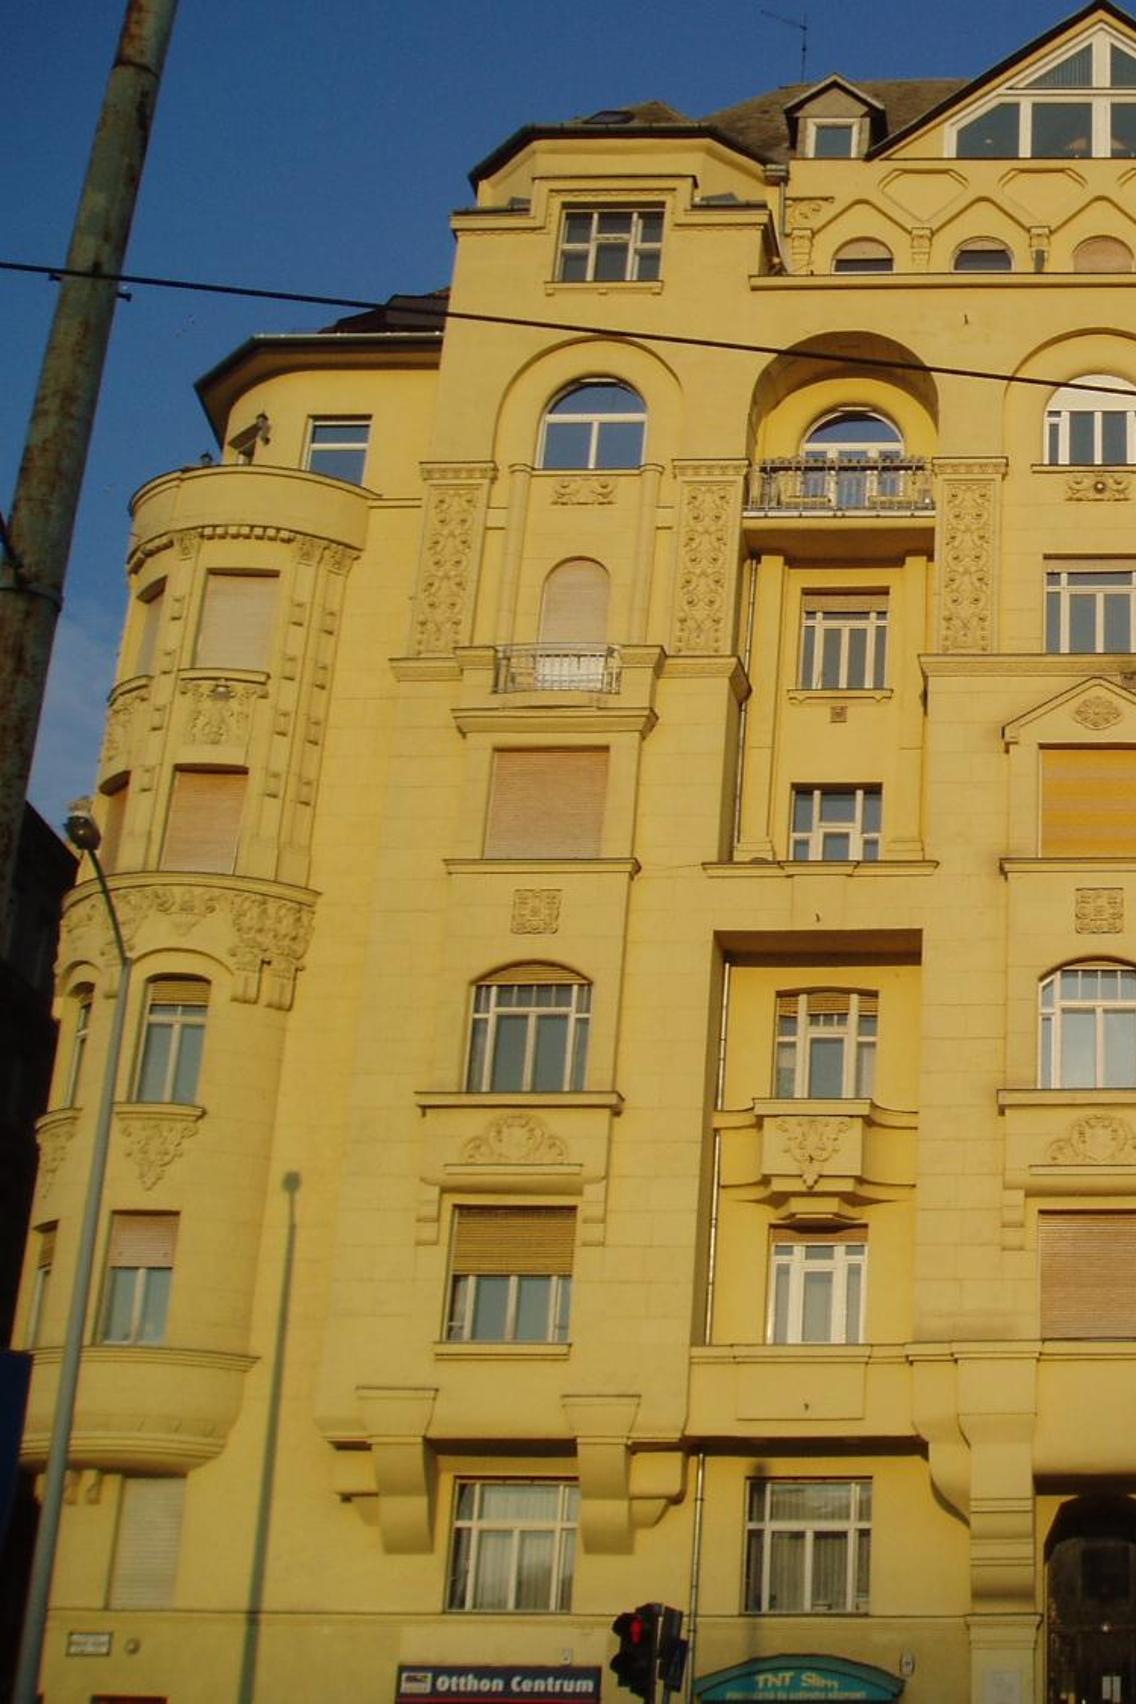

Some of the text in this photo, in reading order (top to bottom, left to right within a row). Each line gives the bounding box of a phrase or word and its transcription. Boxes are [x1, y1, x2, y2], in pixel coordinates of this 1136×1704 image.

[436, 1673, 594, 1693] Otthon Centrum
[756, 1671, 839, 1690] TNT Slim
